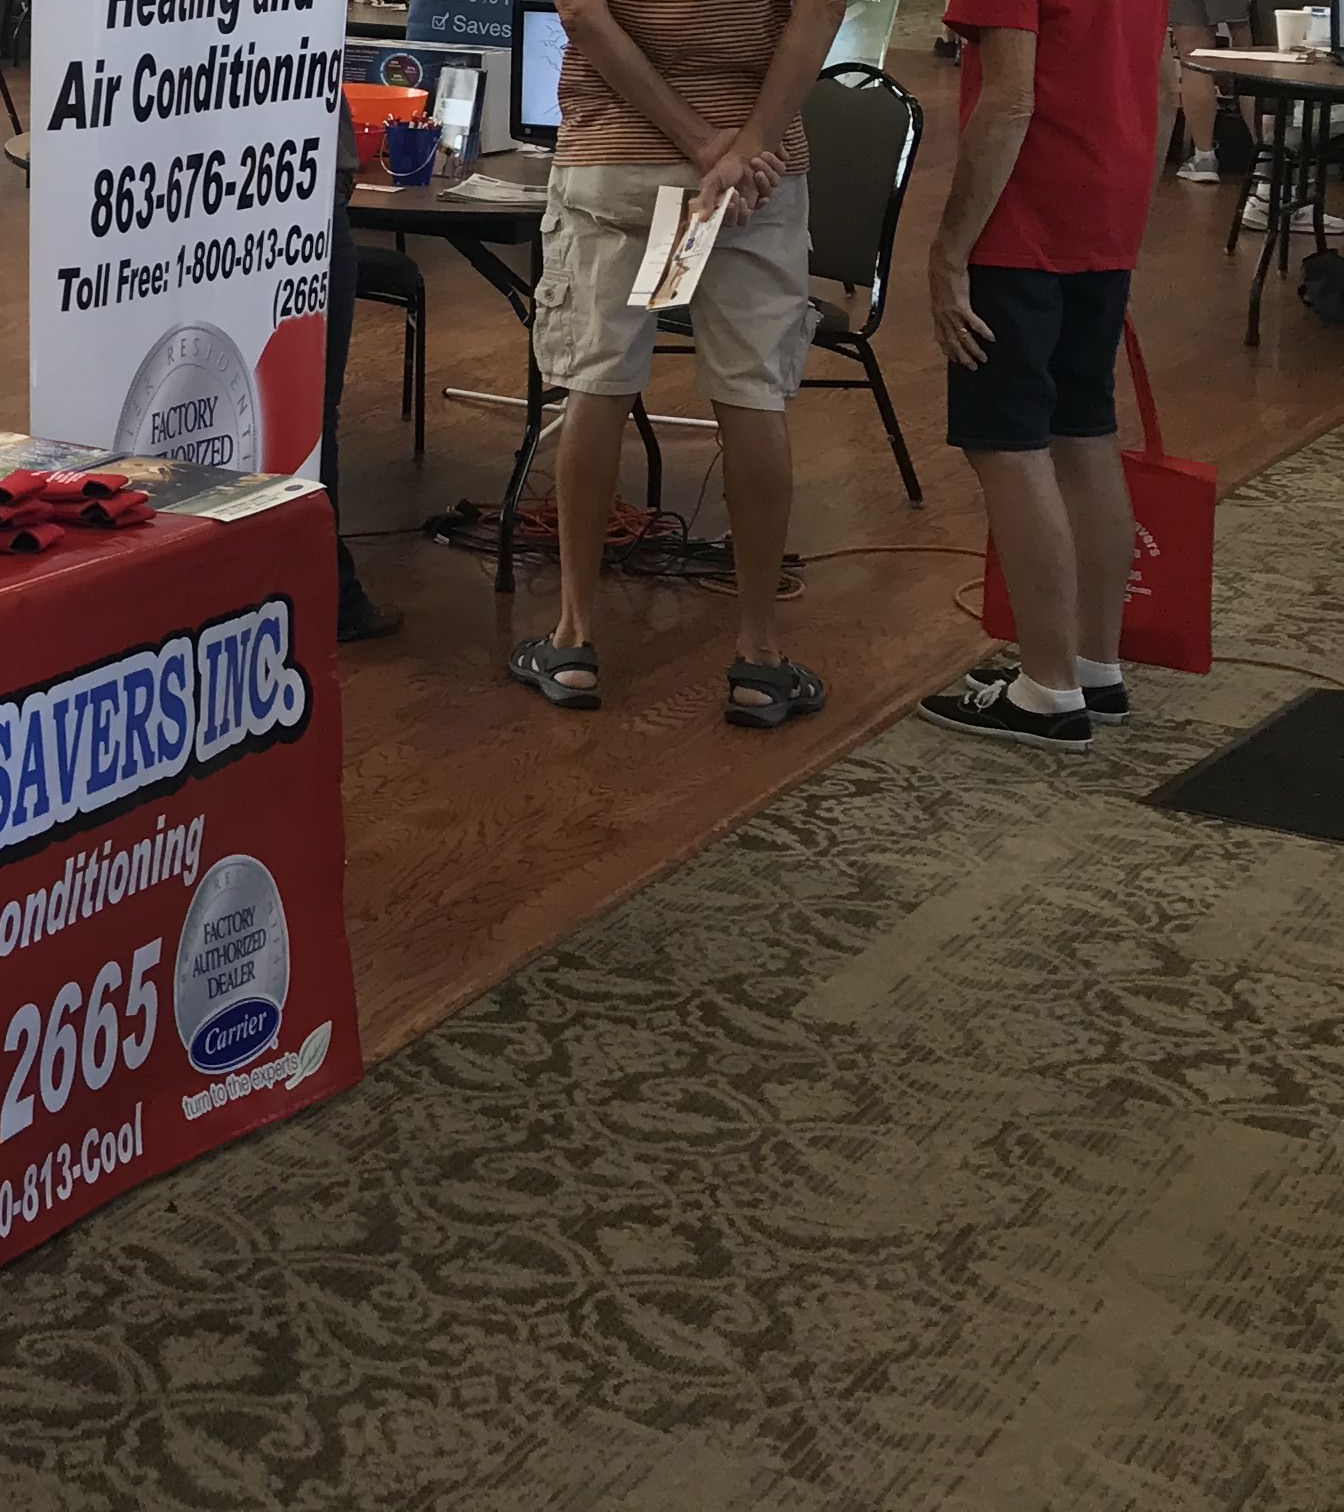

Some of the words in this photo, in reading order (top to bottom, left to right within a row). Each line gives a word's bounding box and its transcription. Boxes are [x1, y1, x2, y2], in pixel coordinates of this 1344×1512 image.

[452, 14, 512, 38] Saves
[47, 58, 122, 131] Air
[133, 36, 342, 123] Conditioning
[91, 137, 319, 237] 863-676-2665
[58, 264, 108, 312] Toll
[116, 258, 170, 304] Free:
[176, 219, 332, 288] 1-800-813-Cool
[272, 271, 328, 329] (2665
[151, 395, 220, 445] FACTORY
[203, 615, 297, 747] INC.
[204, 905, 256, 945] FACTORY
[193, 928, 267, 978] AUTHORIZED
[207, 960, 256, 1000] DEALER
[204, 1009, 268, 1055] Carrier
[184, 1094, 210, 1117] turn
[252, 1055, 299, 1088] experts
